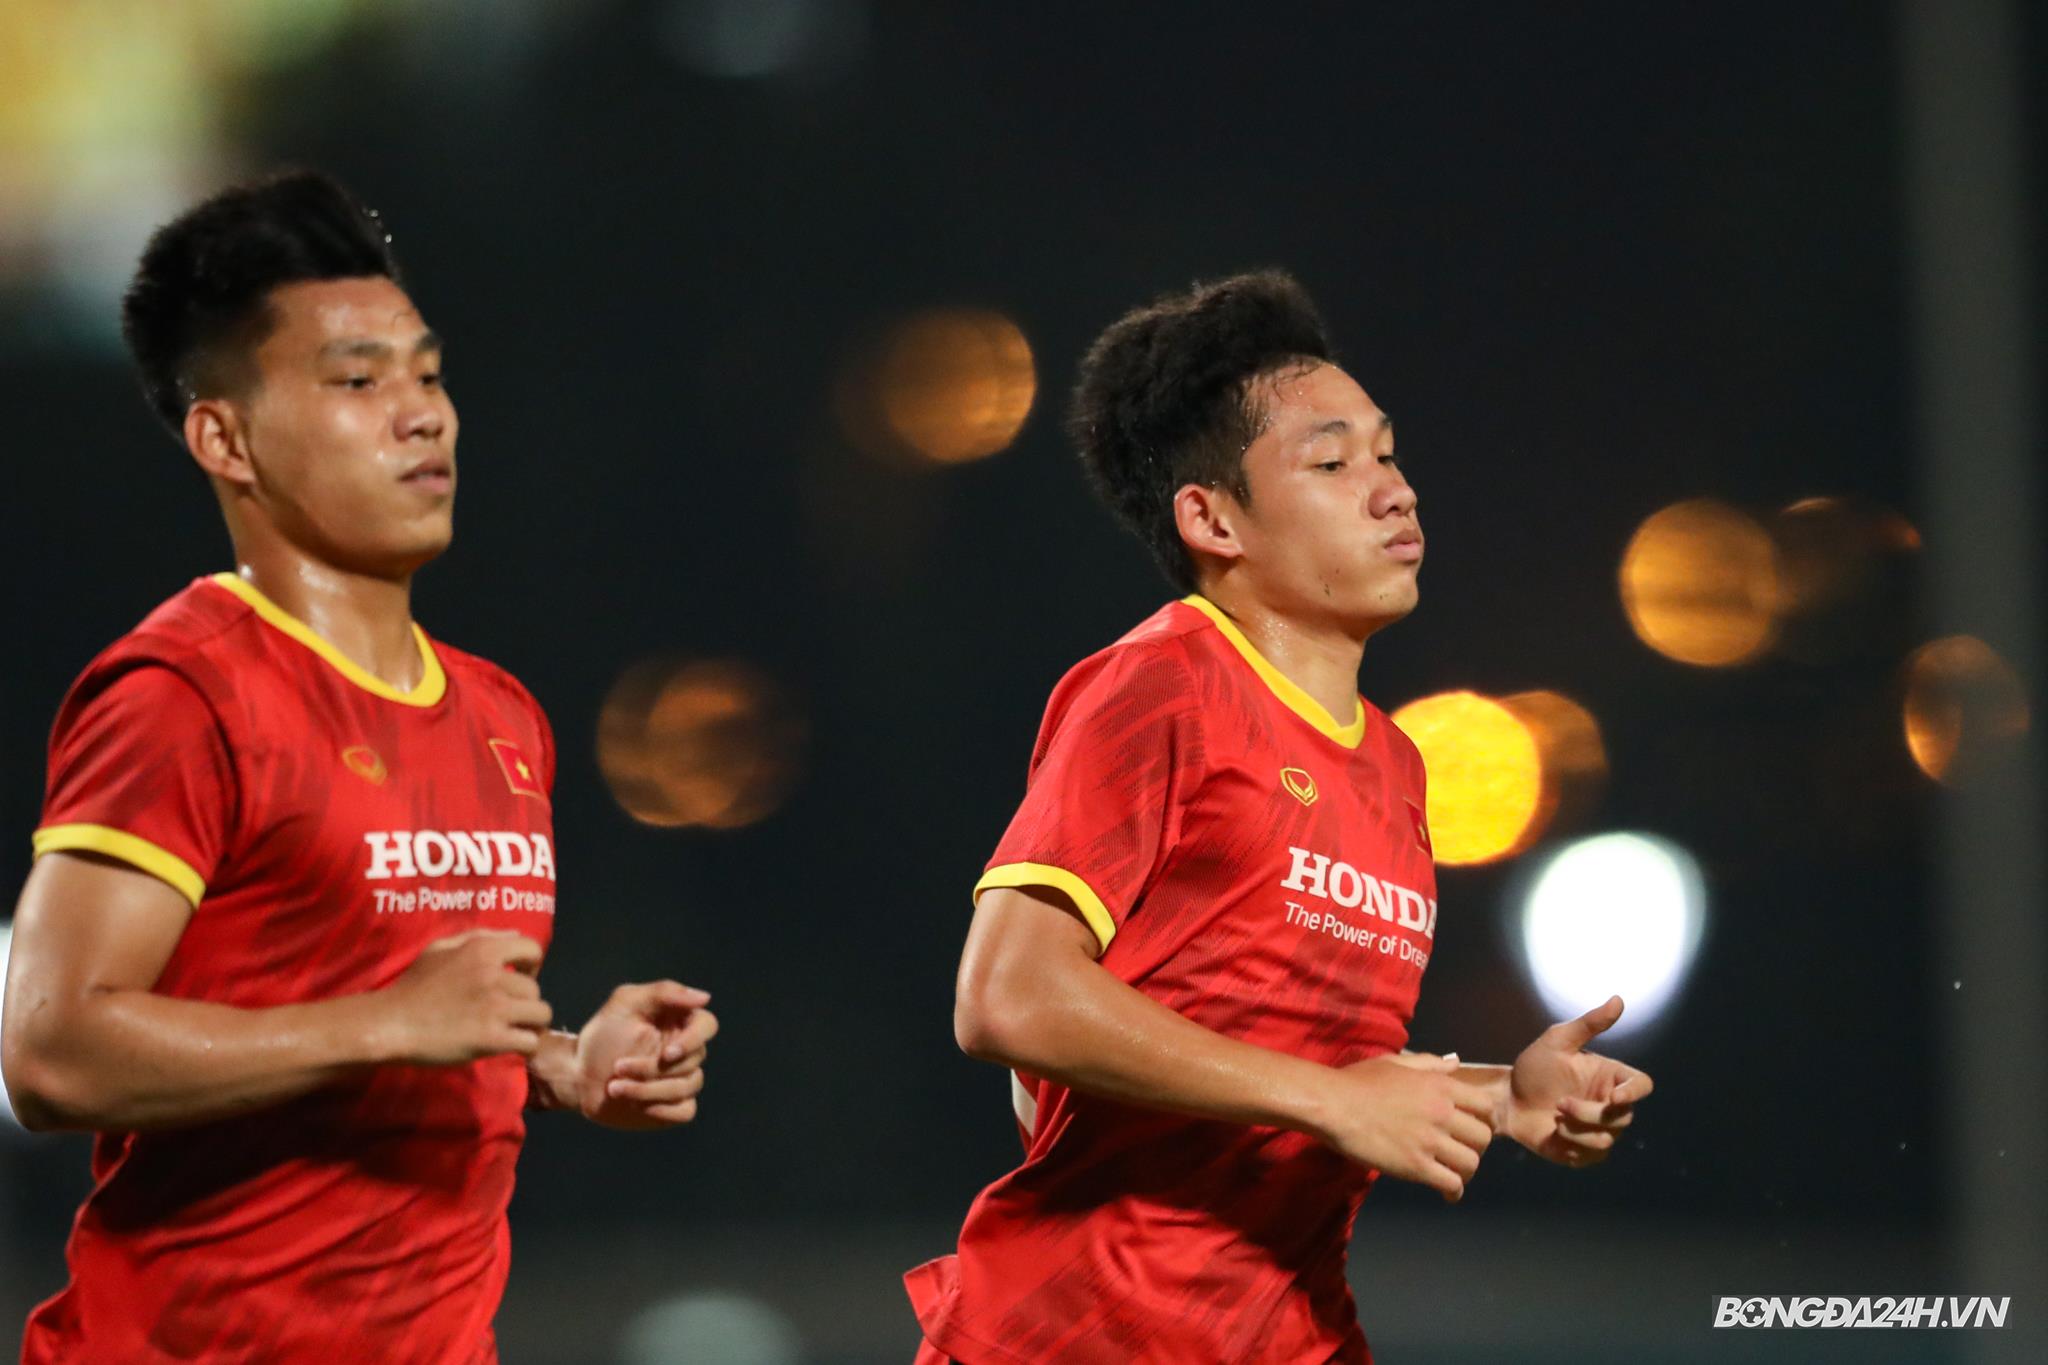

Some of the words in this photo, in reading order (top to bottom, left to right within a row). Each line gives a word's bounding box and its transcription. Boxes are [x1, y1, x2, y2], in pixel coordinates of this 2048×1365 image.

[365, 830, 556, 881] HONDA
[373, 888, 416, 914] The
[418, 886, 473, 912] Power
[476, 885, 498, 911] of
[1285, 901, 1320, 930] The
[1322, 912, 1377, 949] Power
[1379, 935, 1397, 955] of
